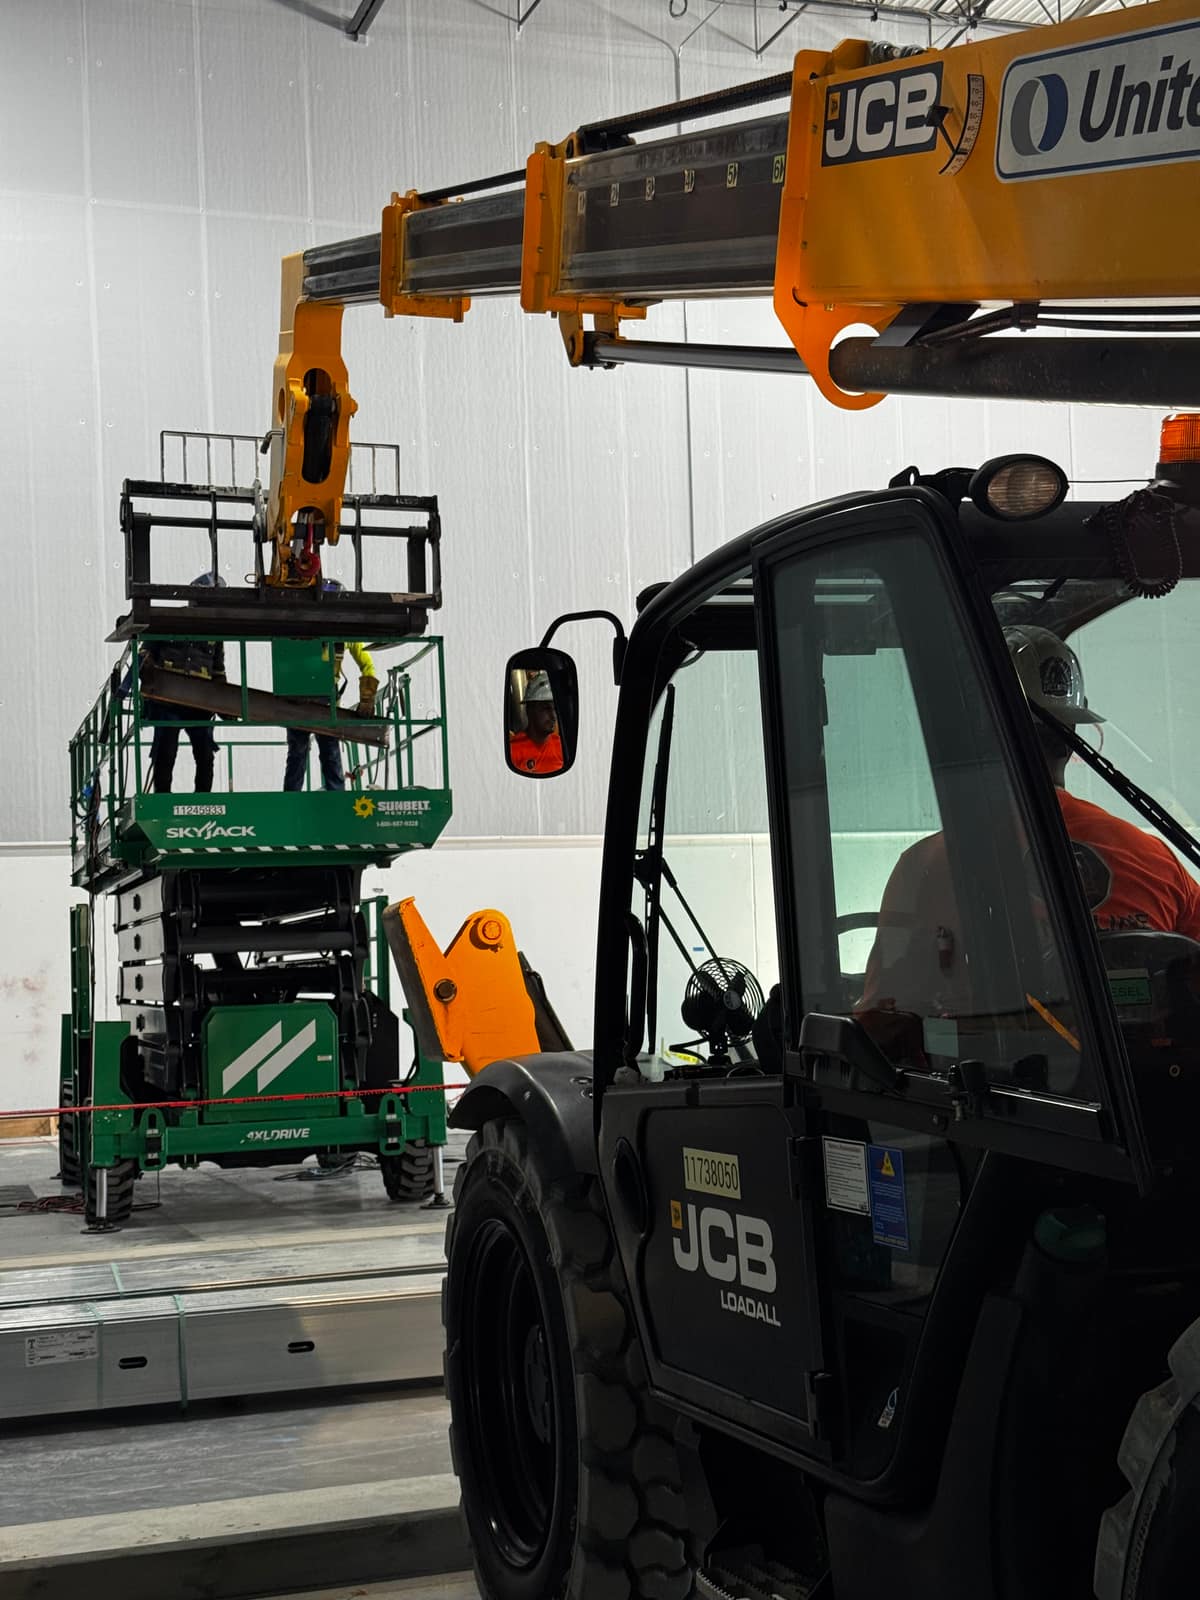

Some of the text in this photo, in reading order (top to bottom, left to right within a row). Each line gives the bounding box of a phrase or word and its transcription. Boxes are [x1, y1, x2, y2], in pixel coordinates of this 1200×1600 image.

[826, 72, 938, 158] JCB
[377, 800, 431, 811] SUNBELT
[166, 820, 257, 840] SKYJACK
[685, 1155, 739, 1191] 11738050
[672, 1203, 778, 1294] JCB
[720, 1289, 782, 1327] LOADALL
